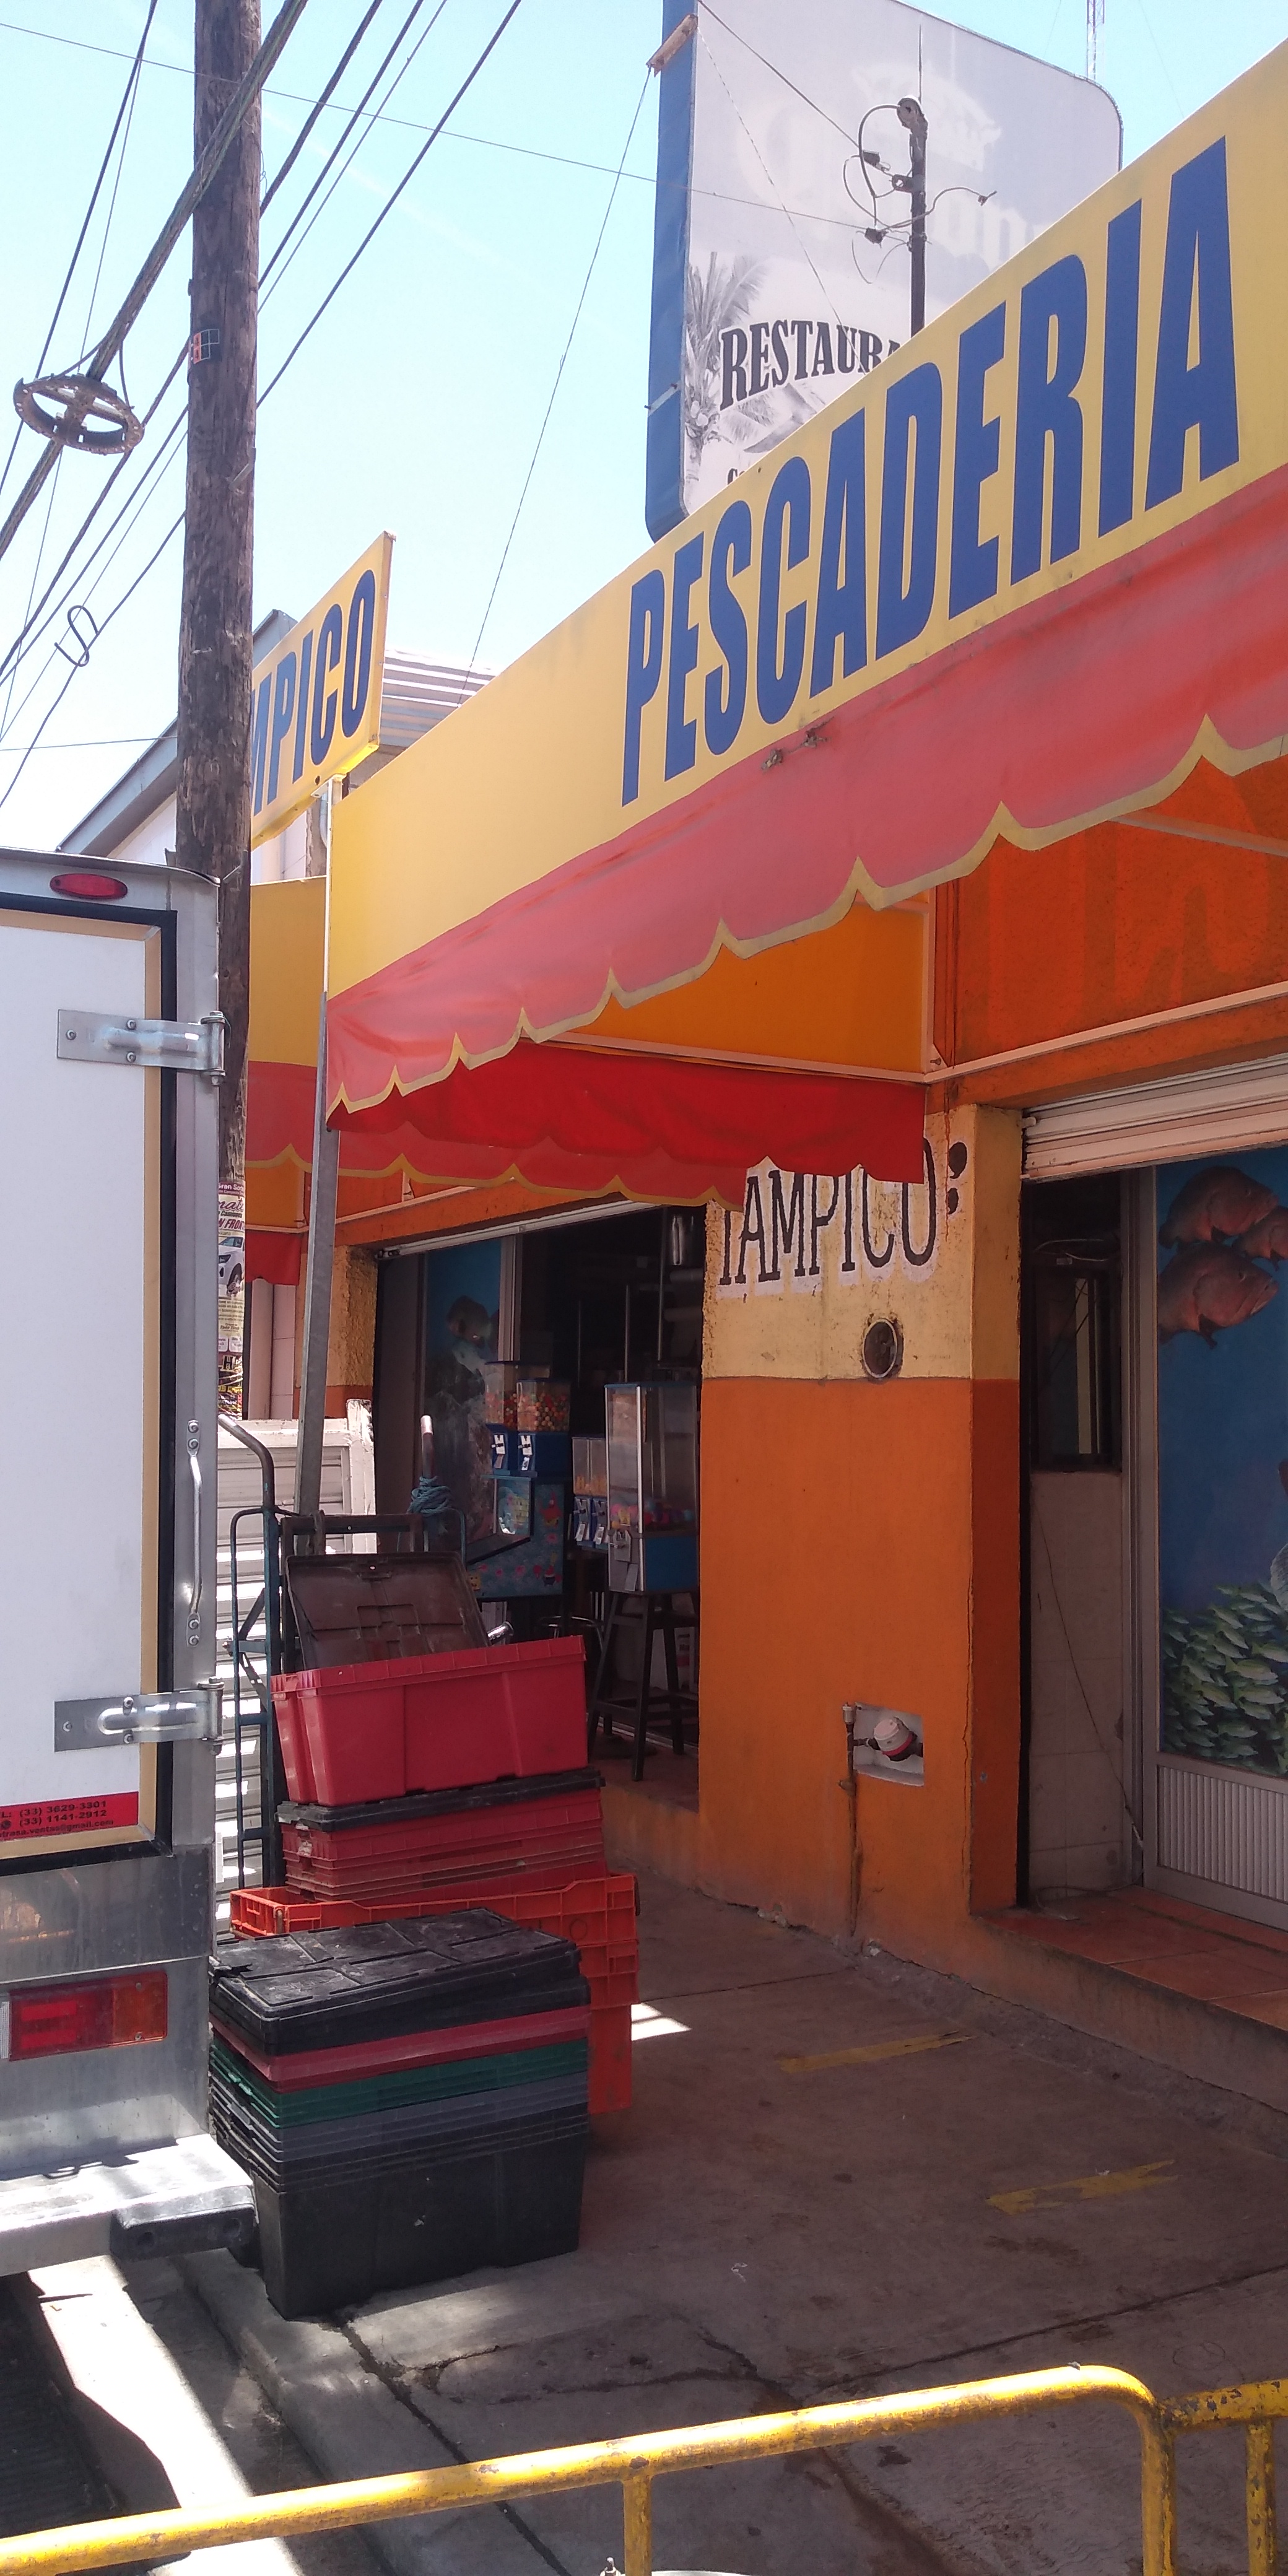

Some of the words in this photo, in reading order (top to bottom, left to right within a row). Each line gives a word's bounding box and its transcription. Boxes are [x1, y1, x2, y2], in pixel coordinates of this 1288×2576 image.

[622, 135, 1239, 807] PESCADERIA
[20, 1807, 42, 1817] (33)
[0, 1820, 113, 1838] trasa.ventas@gmail.com
[20, 1817, 42, 1827] (33)
